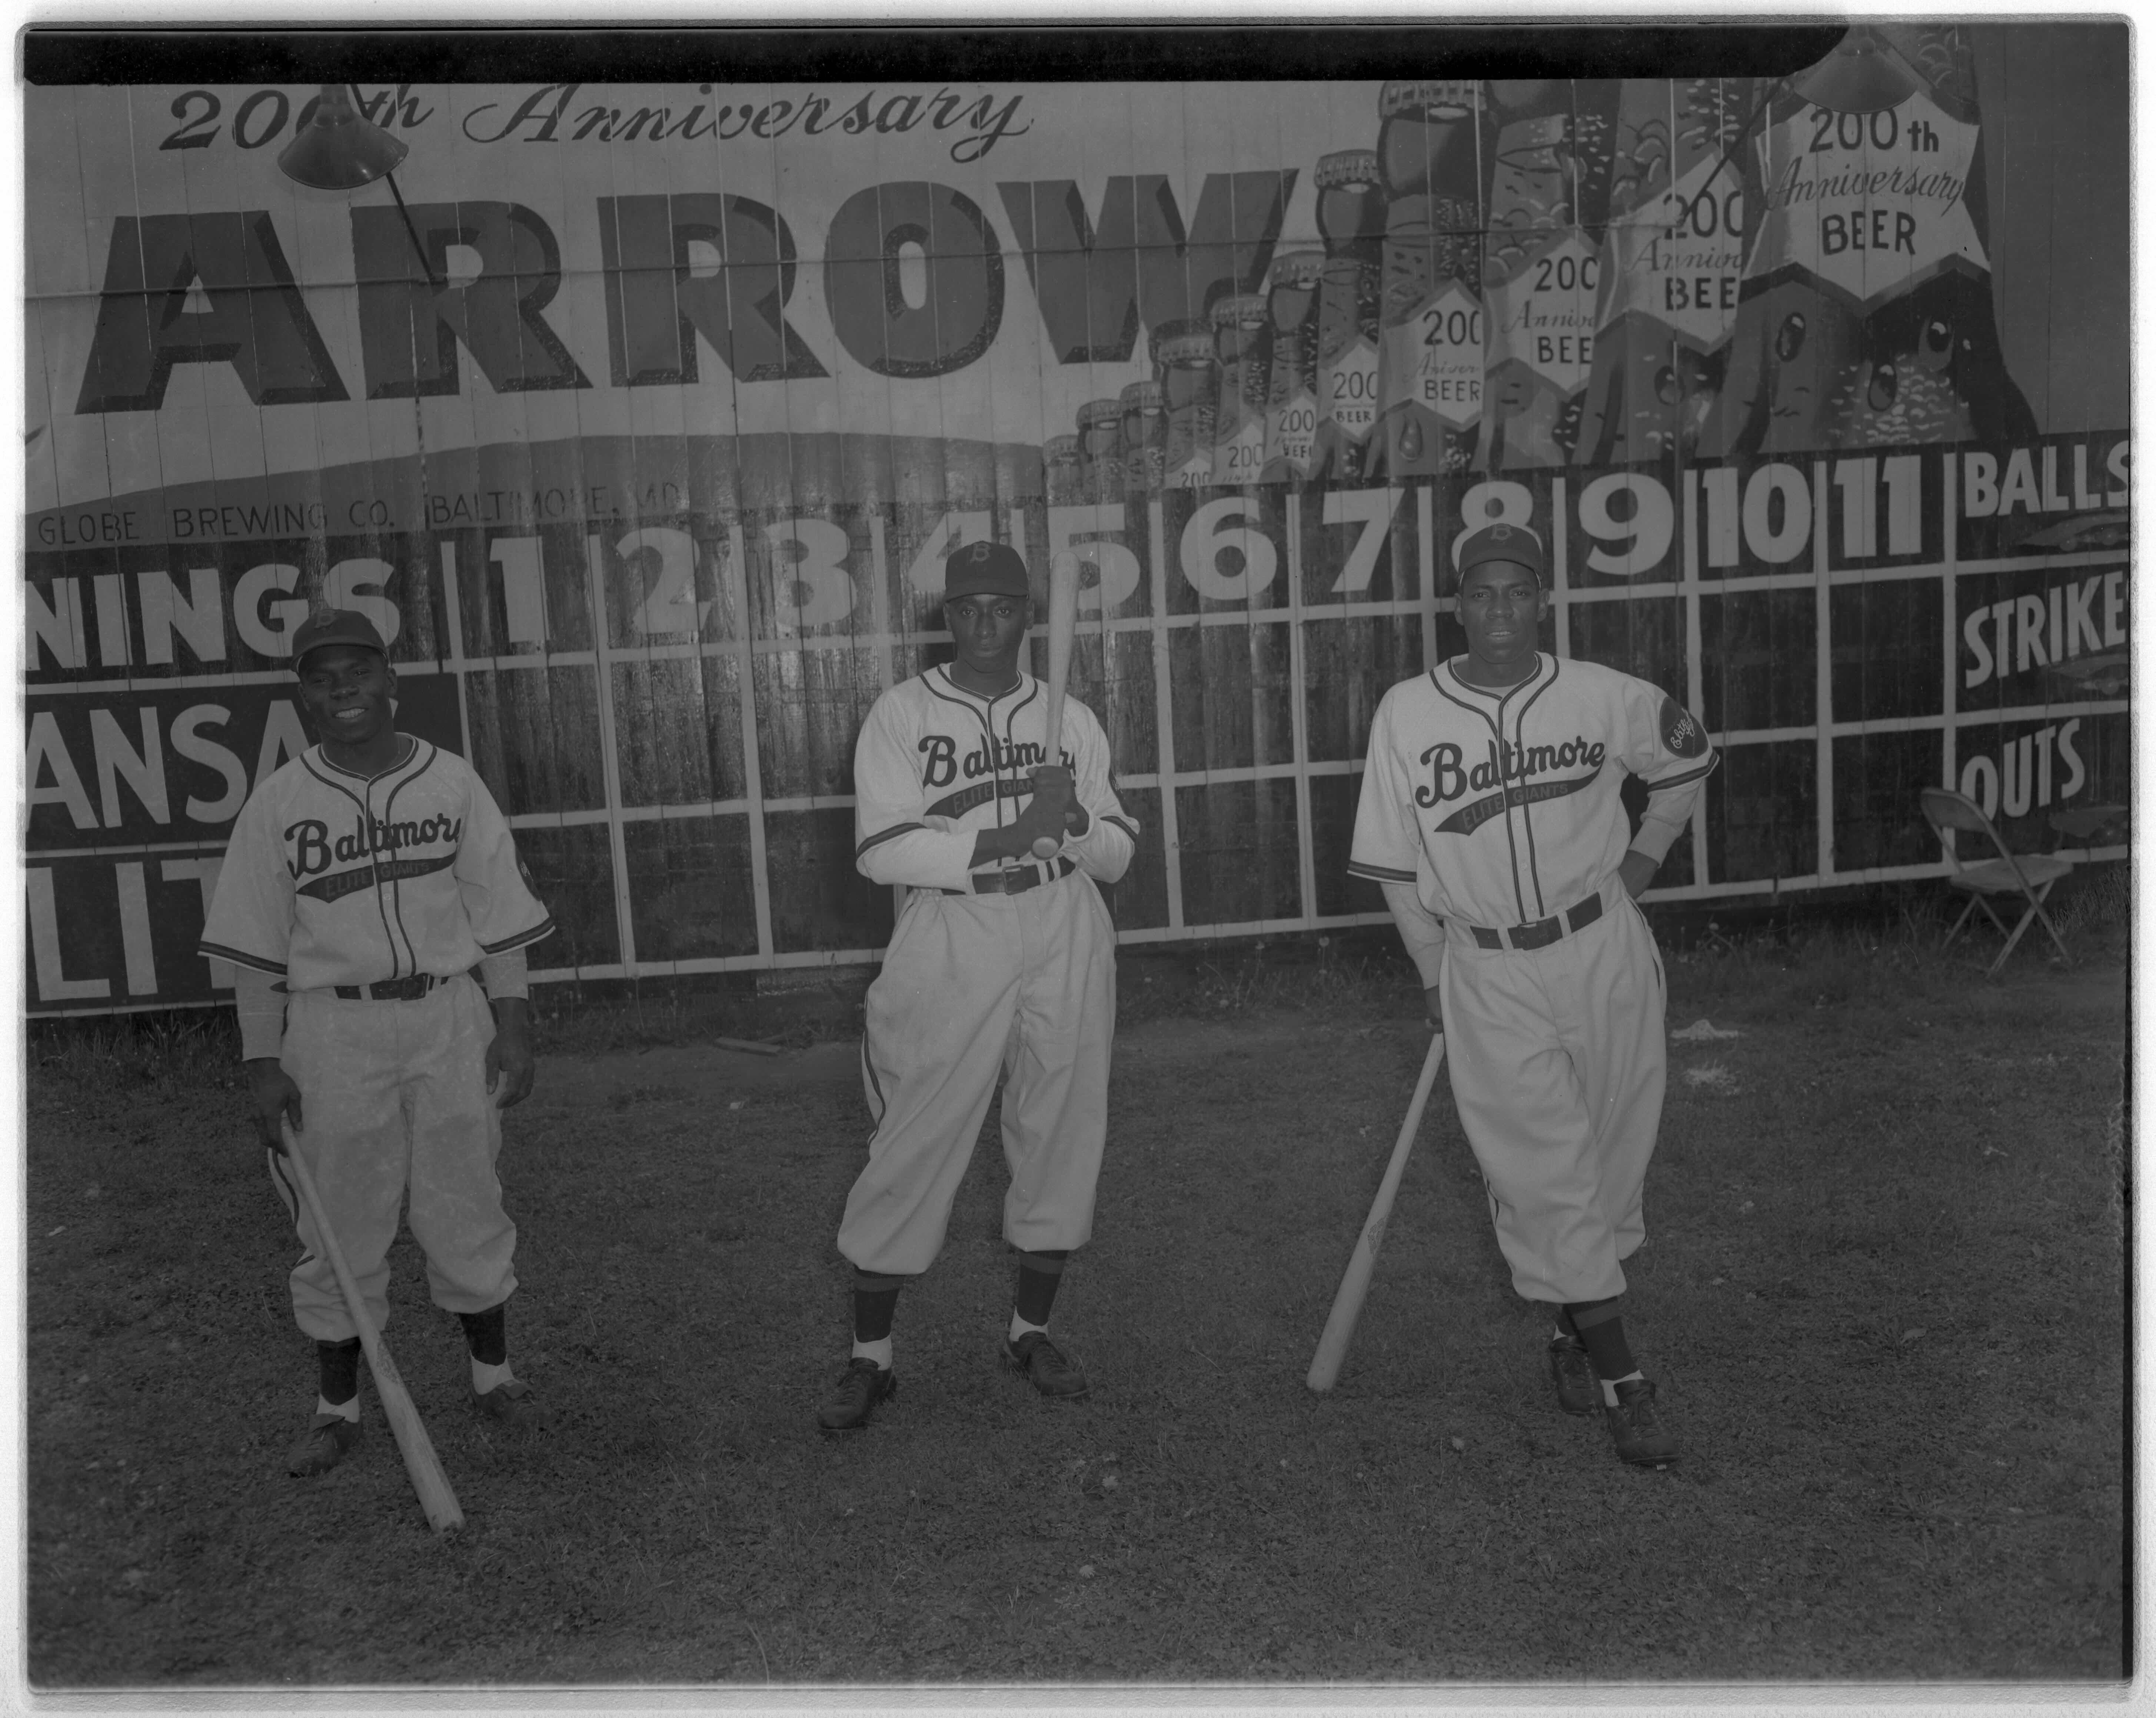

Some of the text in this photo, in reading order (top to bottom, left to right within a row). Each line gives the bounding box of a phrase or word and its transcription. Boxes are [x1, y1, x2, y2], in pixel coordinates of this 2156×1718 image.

[463, 84, 1034, 163] Anniversary
[1766, 156, 1965, 219] Anniversary
[1821, 210, 1915, 256] BEER
[74, 171, 1300, 415] ARROW
[1278, 409, 1314, 432] 200
[1336, 410, 1372, 423] BEER
[38, 510, 140, 546] GLOBE
[172, 502, 328, 538] BREWING
[348, 499, 396, 528] CO.
[489, 536, 550, 643] 1
[616, 526, 713, 634] 2
[763, 518, 857, 627] 3
[1047, 502, 1142, 615] 5
[1179, 496, 1278, 601] 6
[1321, 487, 1405, 593] 7
[1578, 472, 1675, 576] 9
[1702, 462, 1813, 569] 10
[1833, 455, 1923, 559] 11
[1963, 570, 2128, 689] STRIKE
[1415, 736, 1606, 809] Baltimore
[1960, 718, 2085, 819] OUTS
[953, 782, 993, 816] ELITE
[1461, 783, 1568, 830] ELITE GIANTS
[325, 870, 370, 897] ELITE
